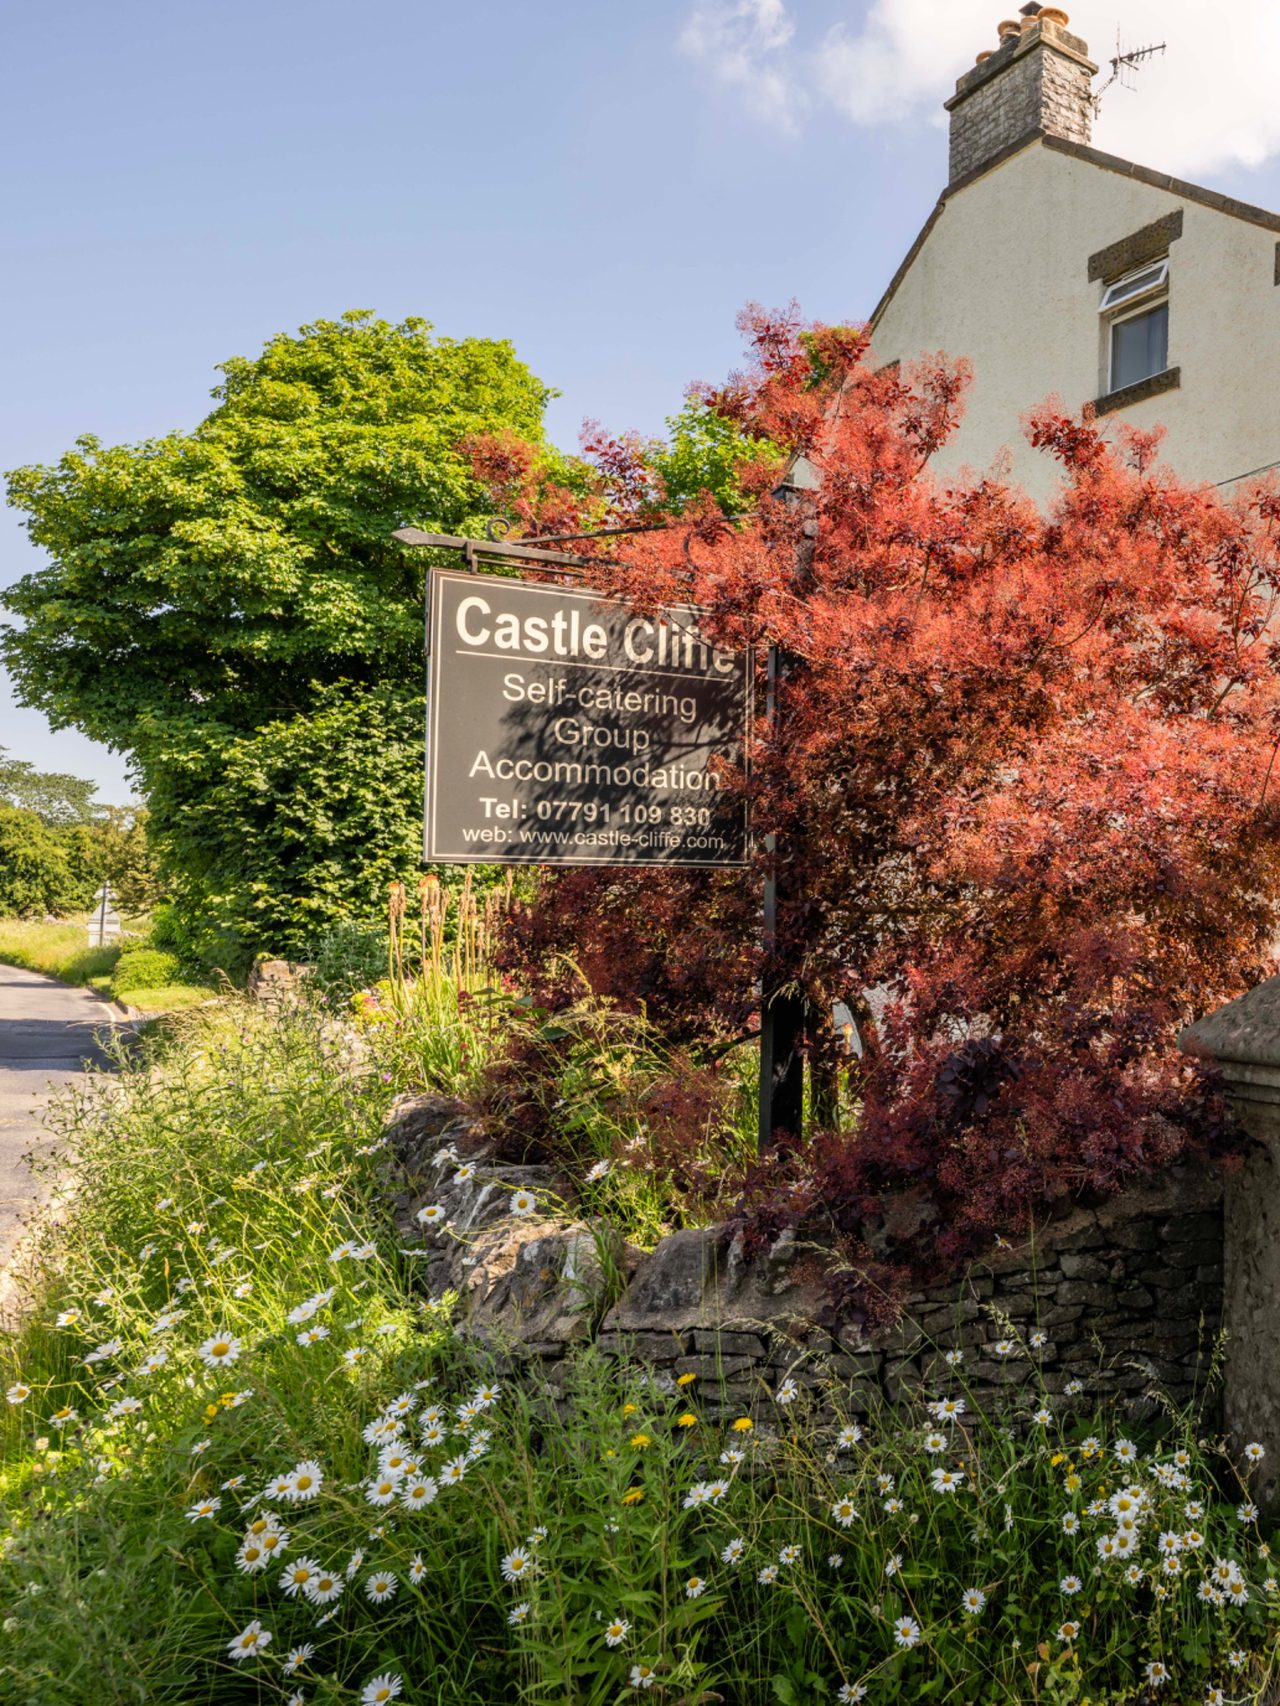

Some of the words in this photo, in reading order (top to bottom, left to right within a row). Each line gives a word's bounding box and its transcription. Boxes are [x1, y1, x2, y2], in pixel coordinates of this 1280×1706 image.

[456, 596, 608, 660] Castle
[624, 618, 735, 673] Cliffe
[502, 673, 697, 723] Self-catering
[554, 717, 650, 755] Group
[469, 750, 720, 791] Accommodation
[479, 797, 527, 820] Tel:
[537, 800, 610, 822] 07791
[620, 804, 662, 825] 109
[670, 806, 710, 827] 830
[462, 826, 512, 844] web:
[520, 829, 724, 850] www.castle-cliffe.com
